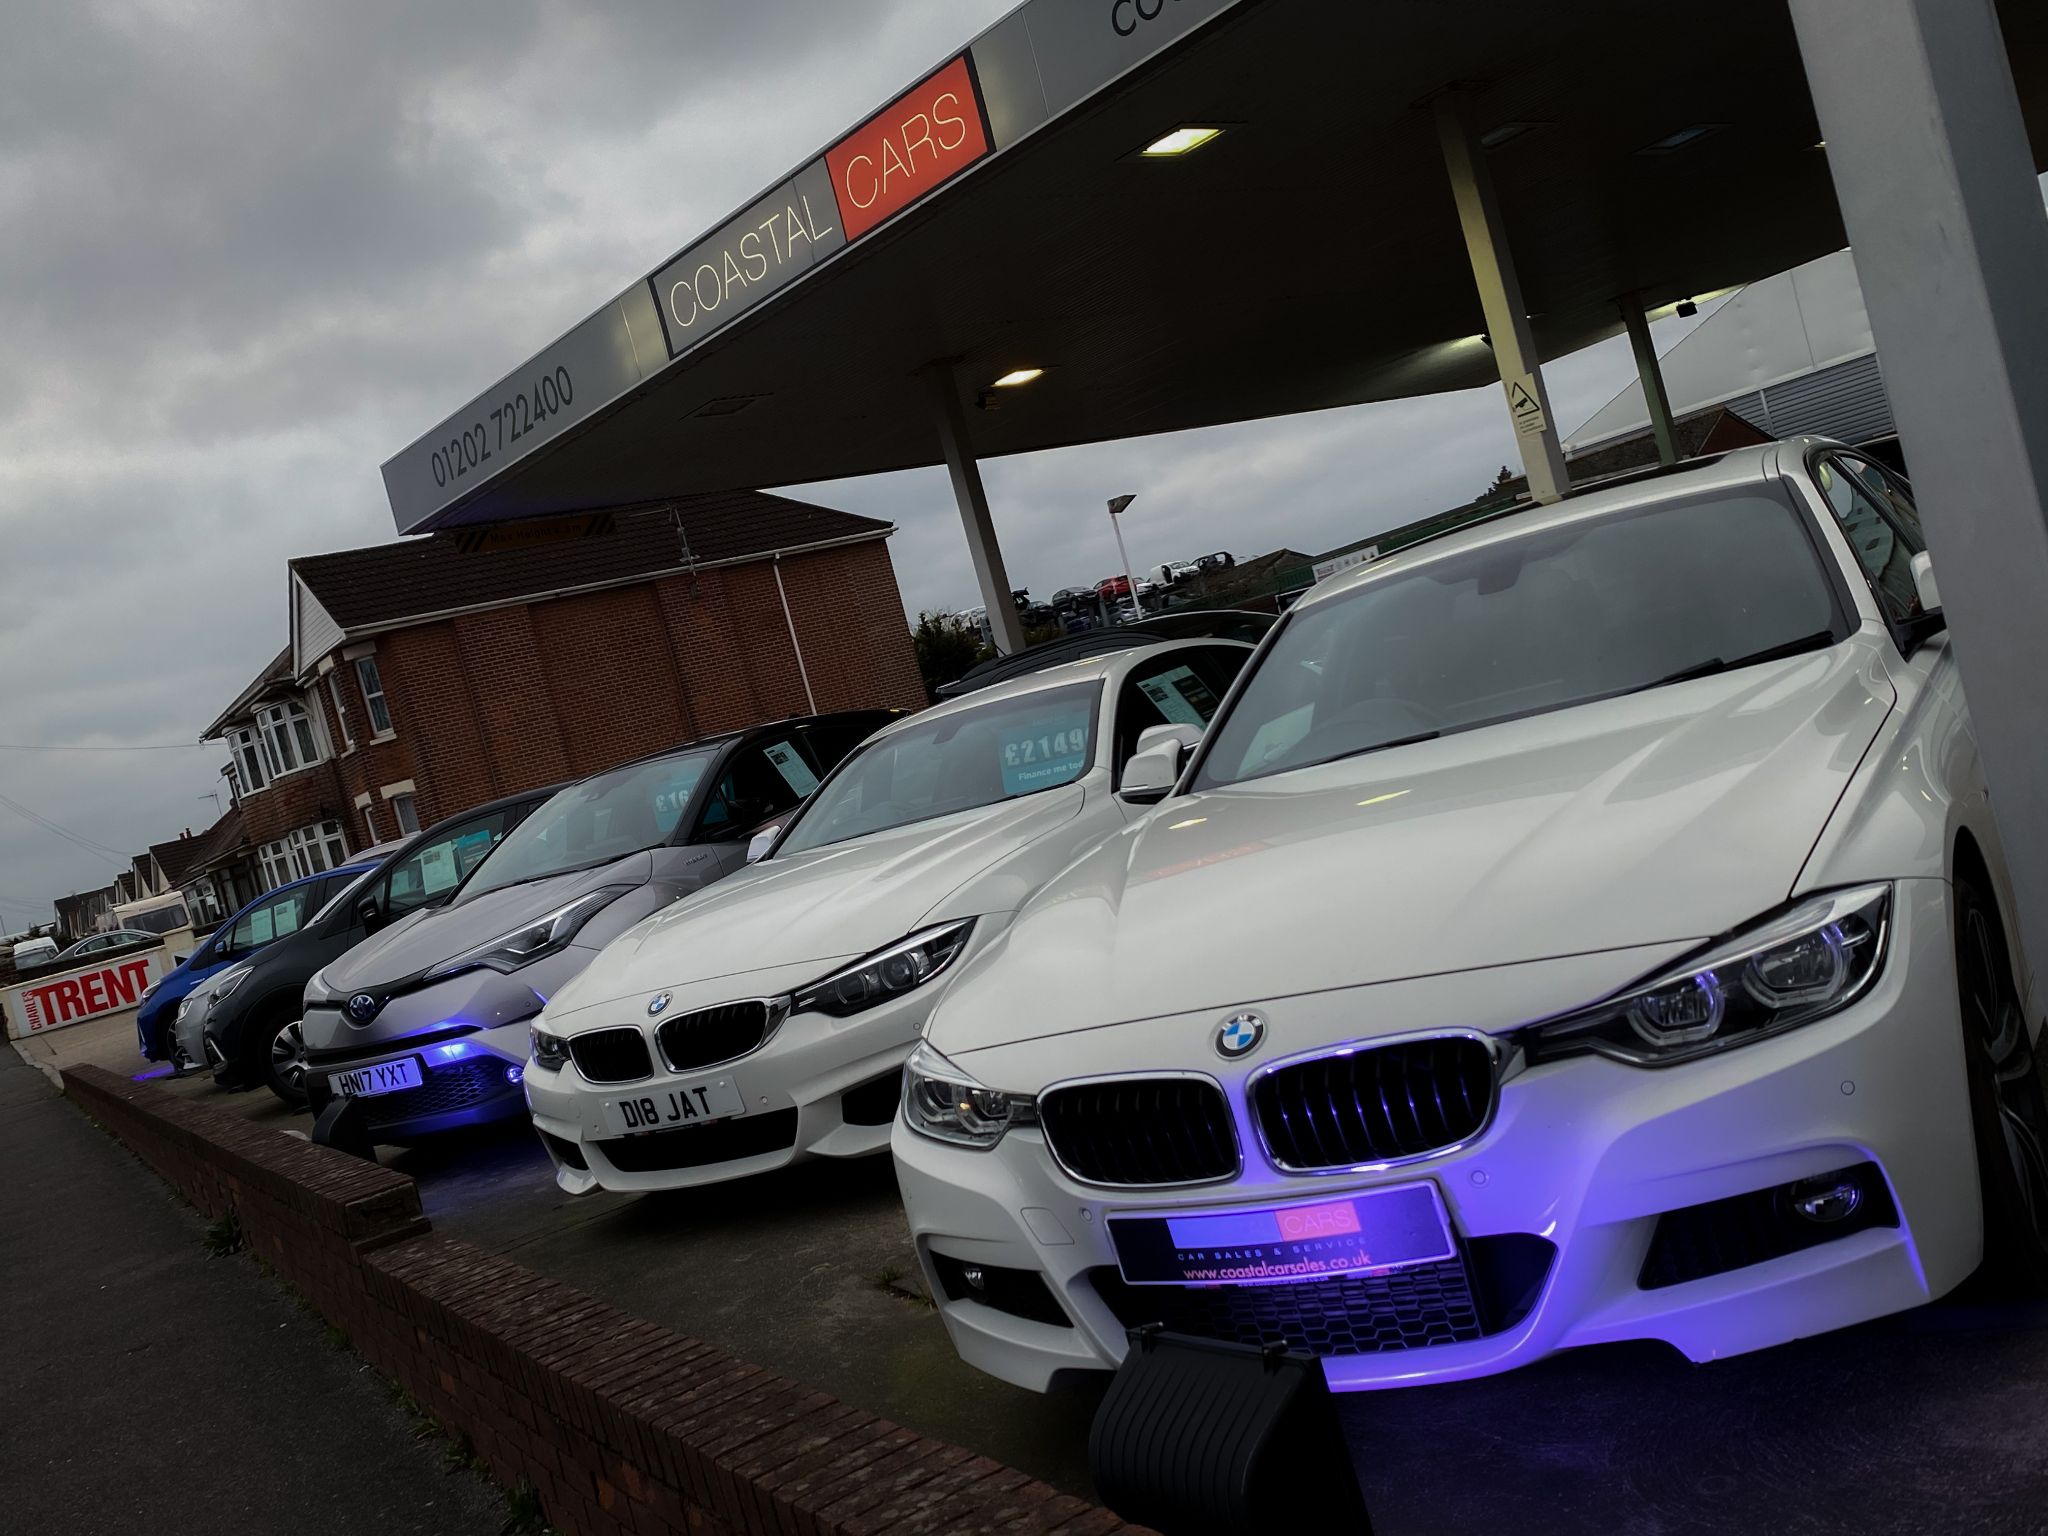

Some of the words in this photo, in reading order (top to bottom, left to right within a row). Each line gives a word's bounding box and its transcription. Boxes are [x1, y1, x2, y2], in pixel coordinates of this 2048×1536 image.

[671, 195, 833, 326] COASTAL
[846, 93, 966, 209] CARS
[431, 423, 491, 487] 01202
[490, 366, 573, 450] 722400
[1018, 767, 1052, 781] Finance
[1053, 764, 1067, 774] me
[21, 990, 43, 1031] CHARLES
[32, 959, 150, 1026] TRENT
[338, 1070, 372, 1095] HN17
[375, 1063, 408, 1088] YXT
[618, 1097, 660, 1129] D18
[667, 1086, 711, 1121] JAT
[1284, 1207, 1352, 1234] CARS
[1177, 1252, 1205, 1262] CAR
[1214, 1249, 1263, 1260] SALES
[1273, 1247, 1282, 1256] &
[1292, 1237, 1367, 1254] SERVICE
[1183, 1249, 1372, 1280] www.coastalcarsales.co.uk
